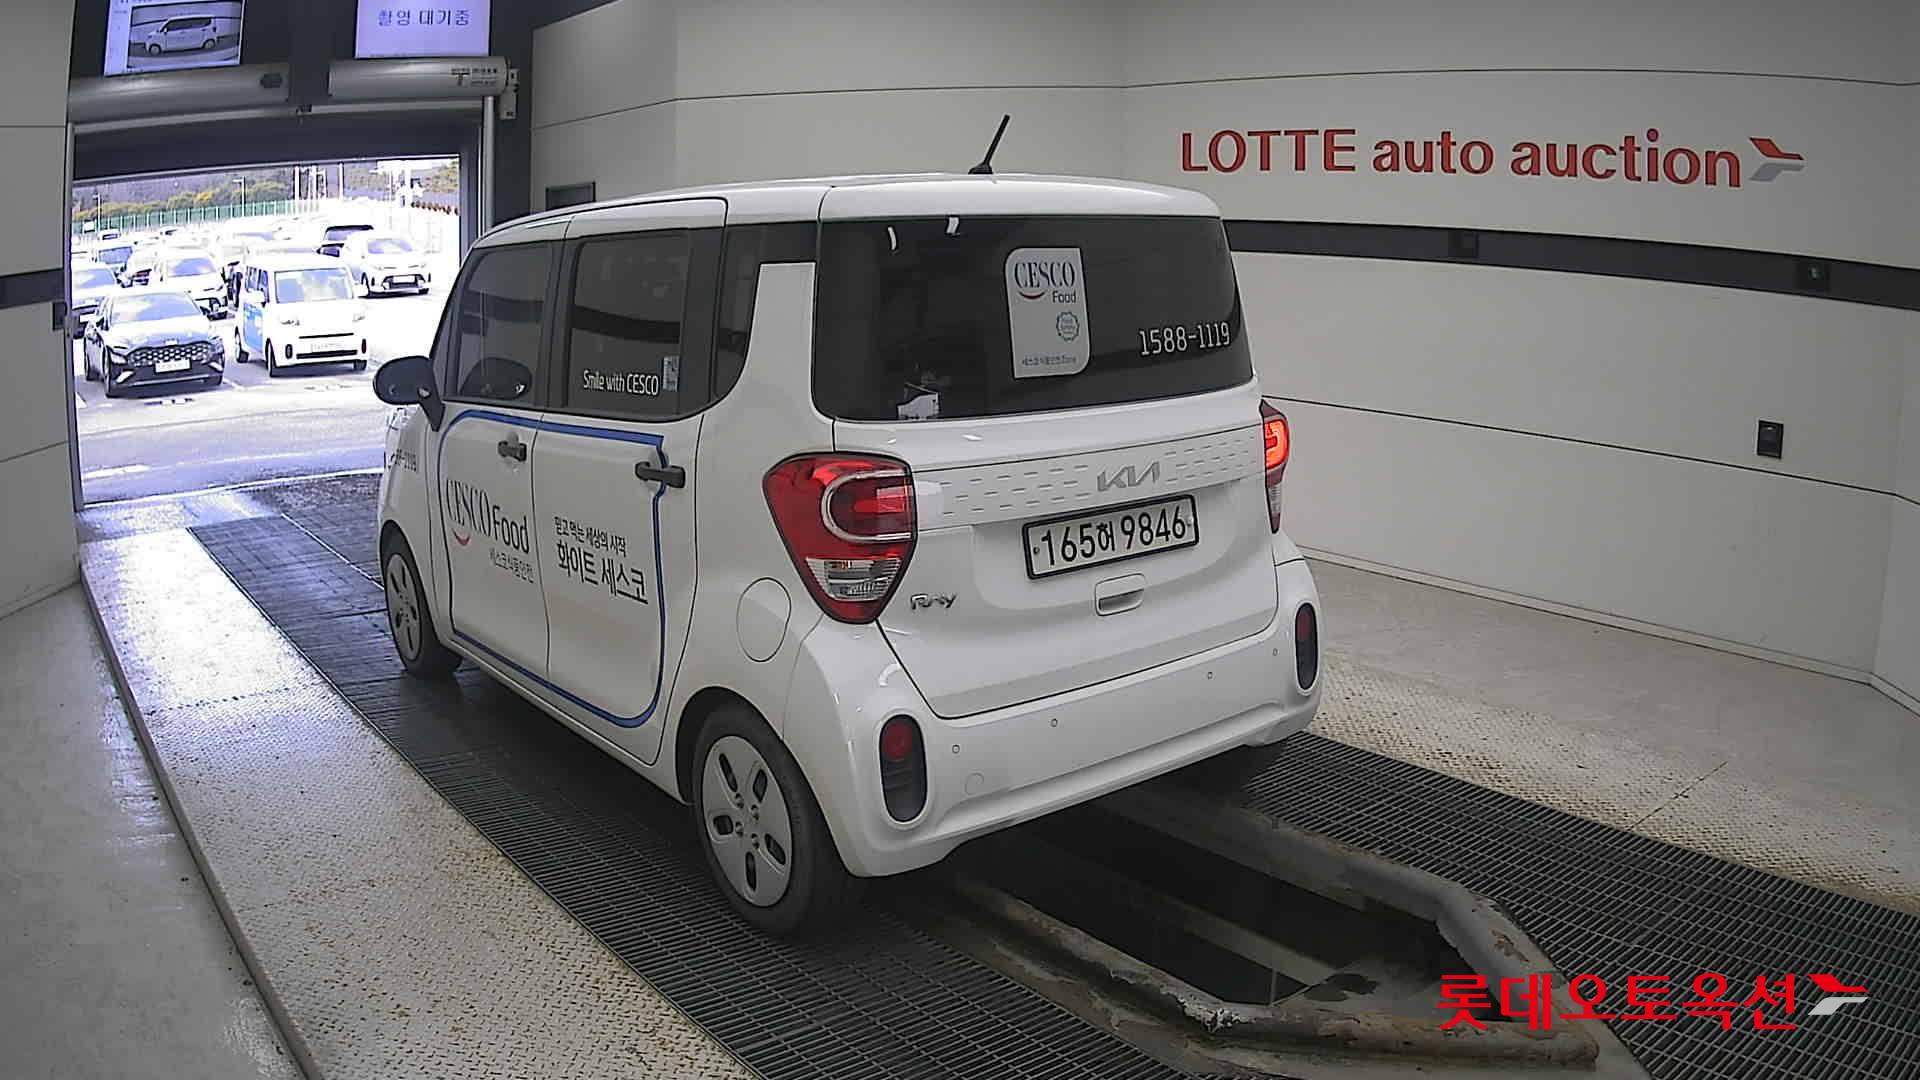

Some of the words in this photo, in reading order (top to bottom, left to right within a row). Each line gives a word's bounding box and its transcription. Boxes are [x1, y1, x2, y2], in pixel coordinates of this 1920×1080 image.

[419, 9, 471, 27] 대기중
[1181, 128, 1357, 174] LOTTE
[1372, 130, 1495, 175] auto
[1510, 128, 1744, 189] auction
[1014, 261, 1076, 288] CESCO
[1052, 290, 1077, 304] Food
[1138, 321, 1231, 356] 1588-1119
[583, 369, 605, 391] Smile
[605, 371, 625, 393] with
[626, 373, 659, 396] CESCO
[445, 478, 491, 538] CESCO
[491, 503, 530, 555] Food
[585, 527, 609, 551] 세상의
[610, 534, 627, 558] 시작
[1041, 520, 1115, 566] 165허
[1120, 505, 1187, 550] 9846
[557, 539, 599, 585] 화이트
[601, 557, 649, 605] 세스코
[910, 592, 957, 610] Ray
